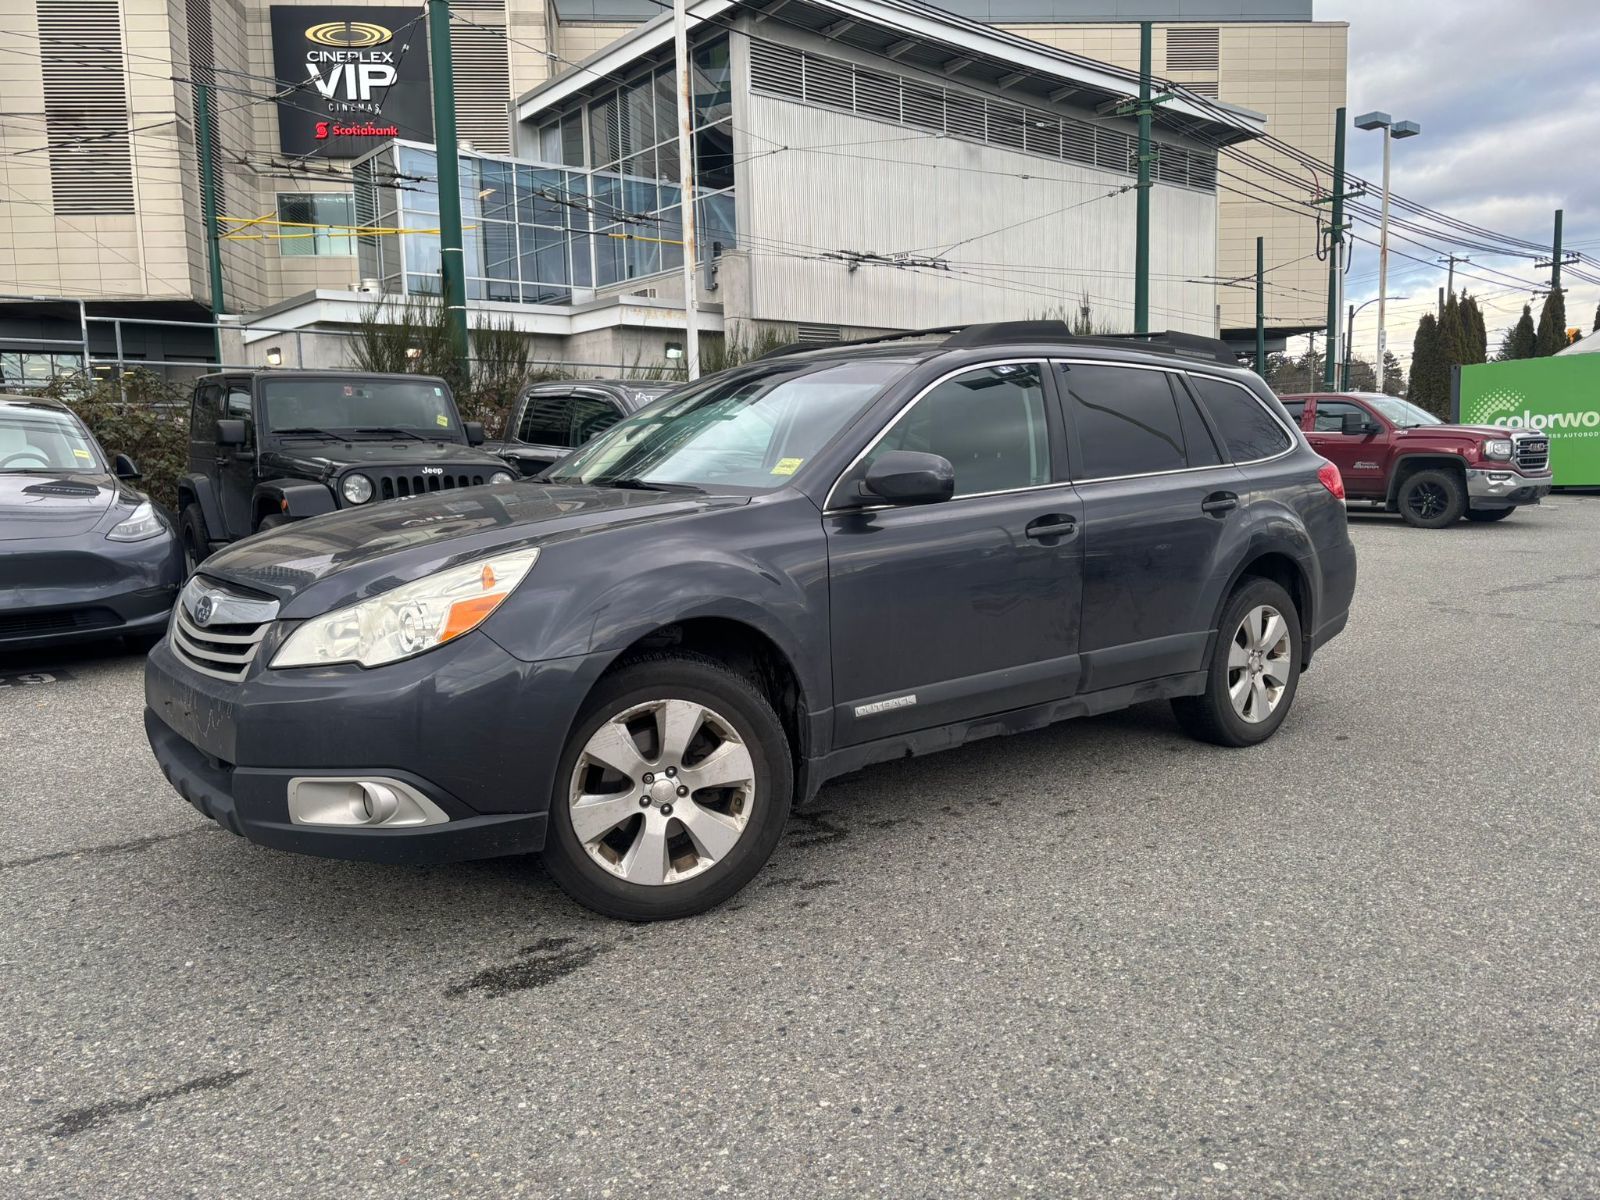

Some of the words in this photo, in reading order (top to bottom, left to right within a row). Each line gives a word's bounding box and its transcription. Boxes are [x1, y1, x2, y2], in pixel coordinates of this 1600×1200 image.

[306, 50, 394, 63] CINEPLEX
[305, 63, 398, 101] VIP
[328, 103, 381, 113] CINEMAS
[332, 122, 398, 136] Scotiabank
[422, 467, 443, 475] Jeep
[856, 695, 916, 716] OUTBACK
